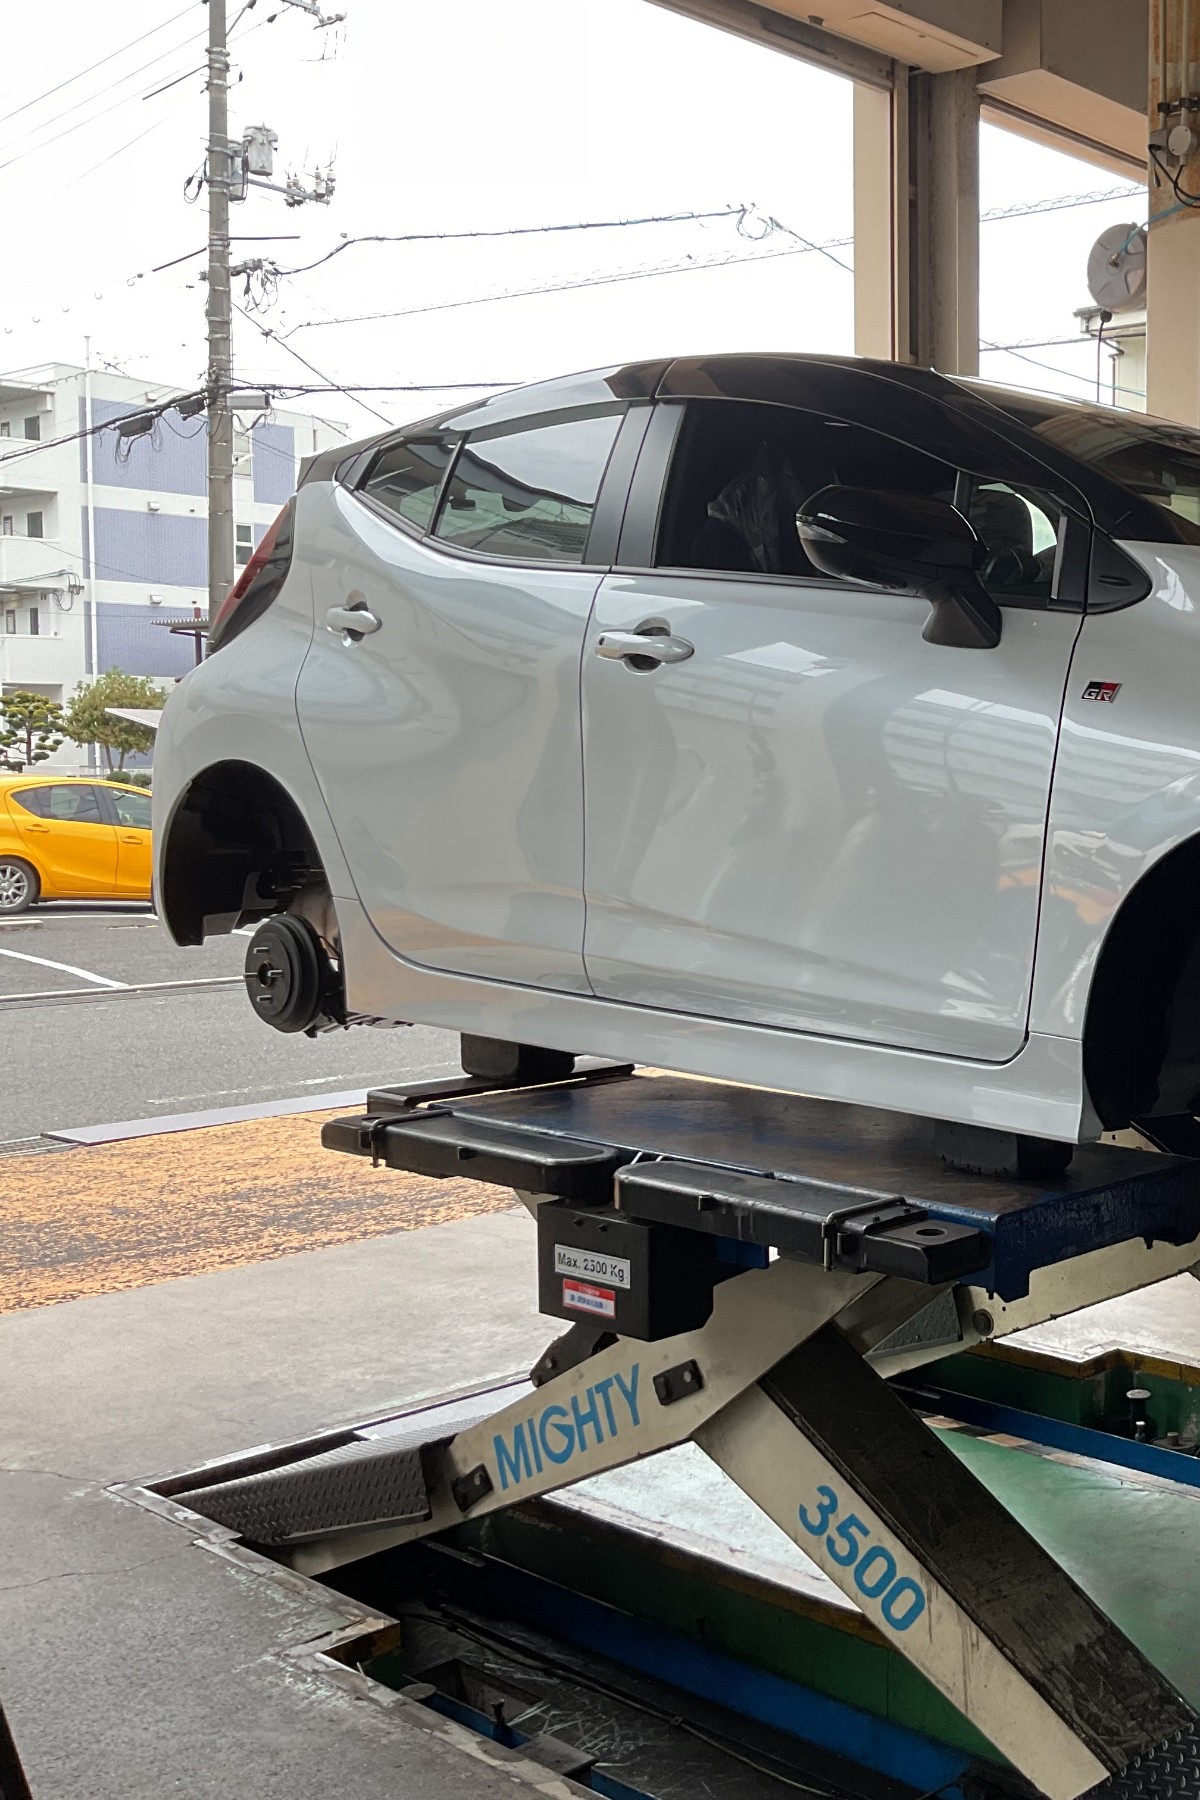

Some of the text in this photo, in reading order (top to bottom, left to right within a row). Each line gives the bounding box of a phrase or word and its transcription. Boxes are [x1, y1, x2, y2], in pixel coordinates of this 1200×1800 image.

[1083, 688, 1114, 701] GR
[557, 1252, 581, 1269] Max.
[494, 1363, 640, 1491] MIGHTY
[799, 1485, 926, 1632] 3500
